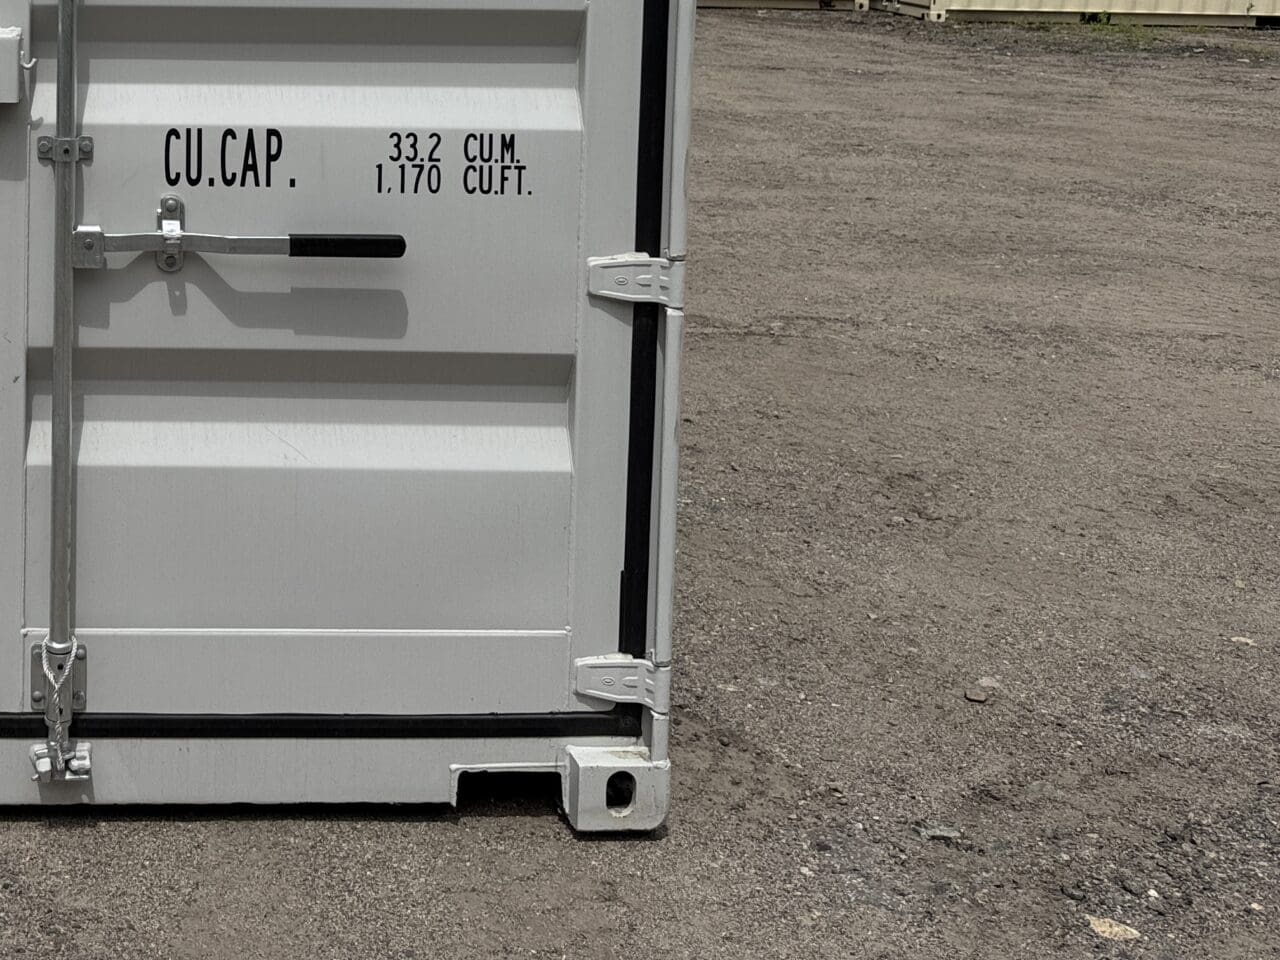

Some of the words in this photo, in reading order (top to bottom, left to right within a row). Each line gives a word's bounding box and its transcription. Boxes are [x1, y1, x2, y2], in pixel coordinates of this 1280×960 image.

[388, 132, 441, 163] 33.2
[463, 133, 521, 163] CU.M.
[375, 163, 441, 195] 1,170
[463, 165, 533, 196] CU.FT.
